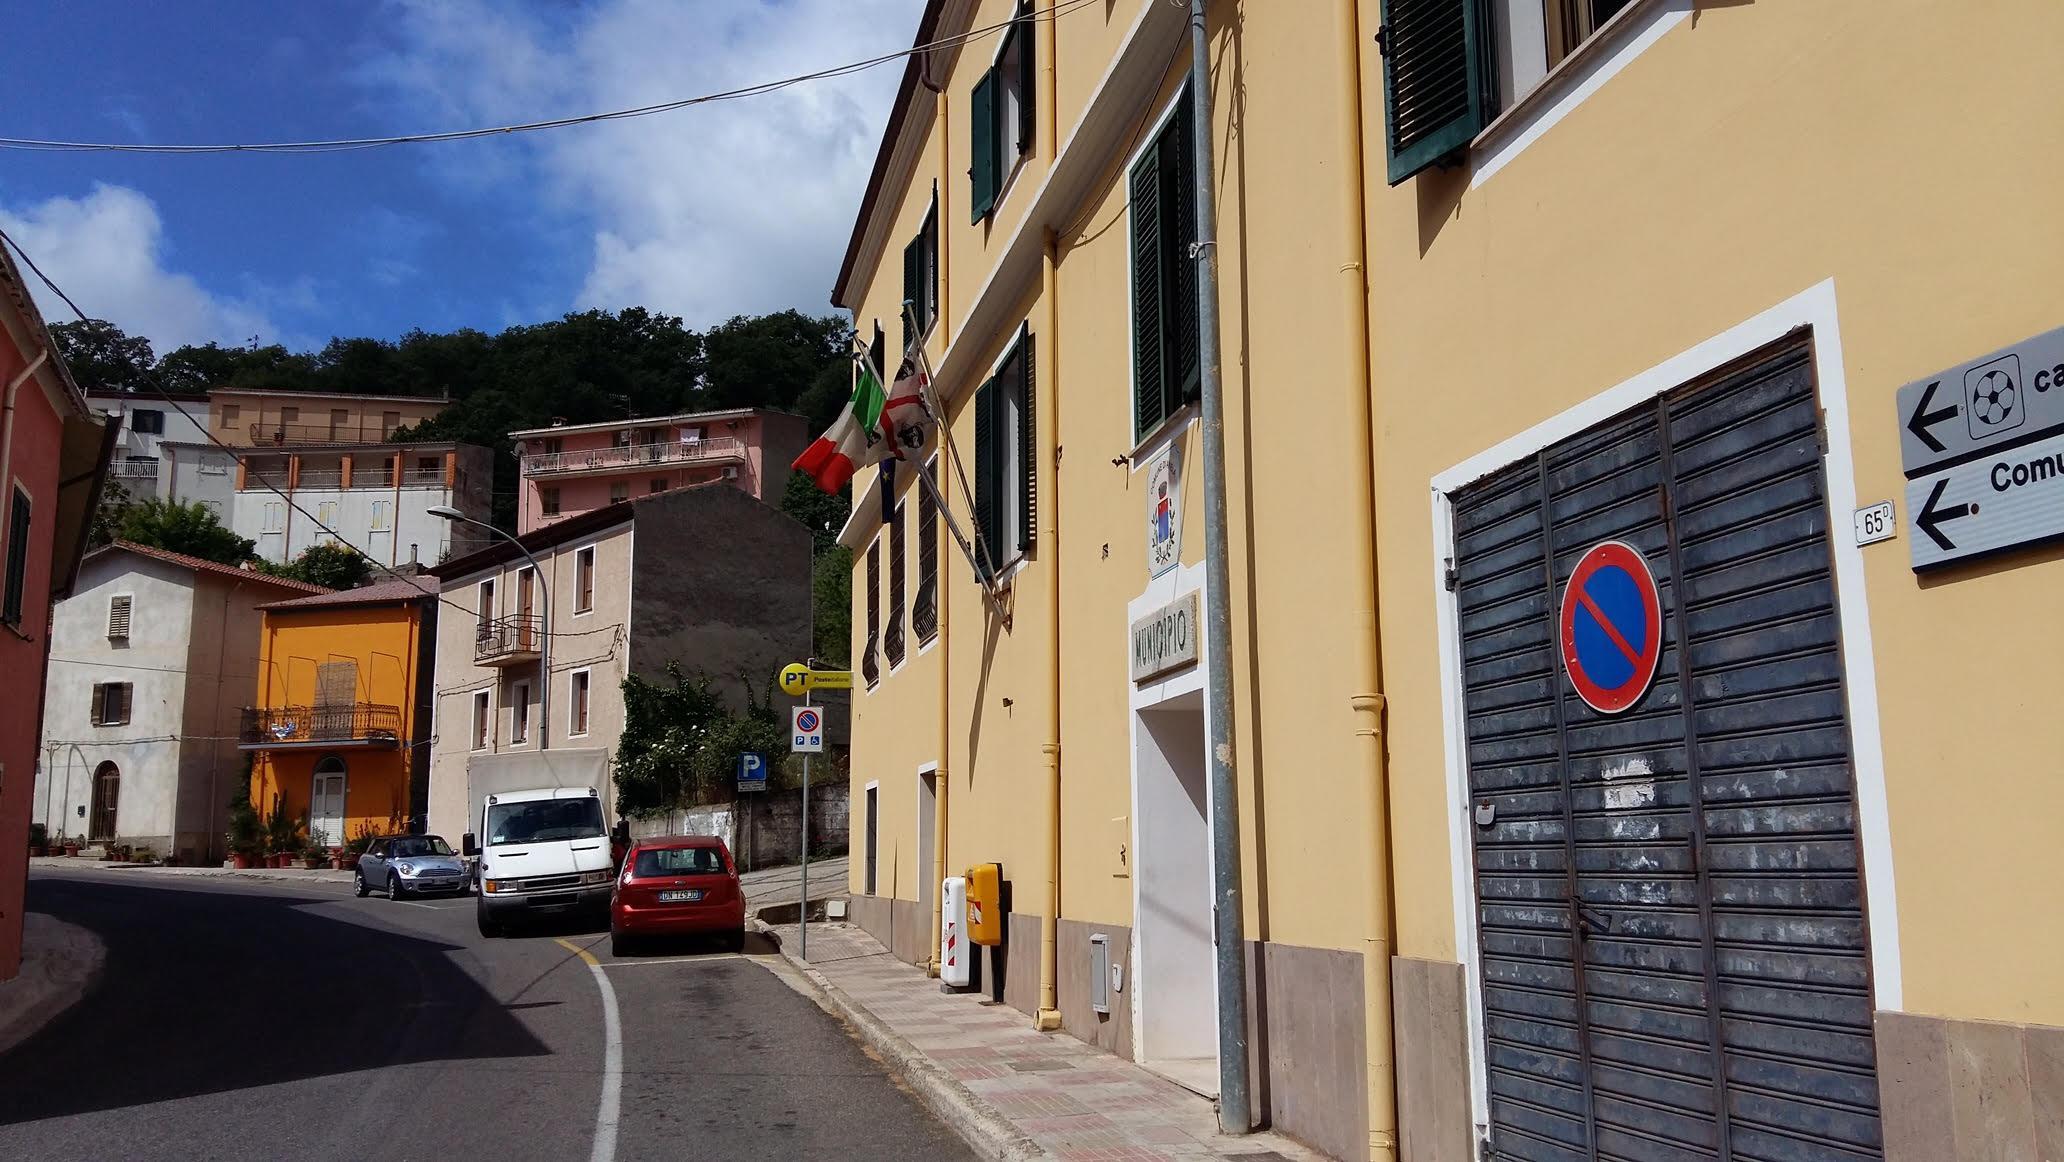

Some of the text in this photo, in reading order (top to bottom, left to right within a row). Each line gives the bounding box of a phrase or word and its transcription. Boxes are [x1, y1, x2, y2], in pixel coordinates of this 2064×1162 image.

[1135, 609, 1187, 669] MUNICIPIO
[785, 672, 808, 686] PT
[797, 737, 804, 745] P
[743, 754, 761, 778] P
